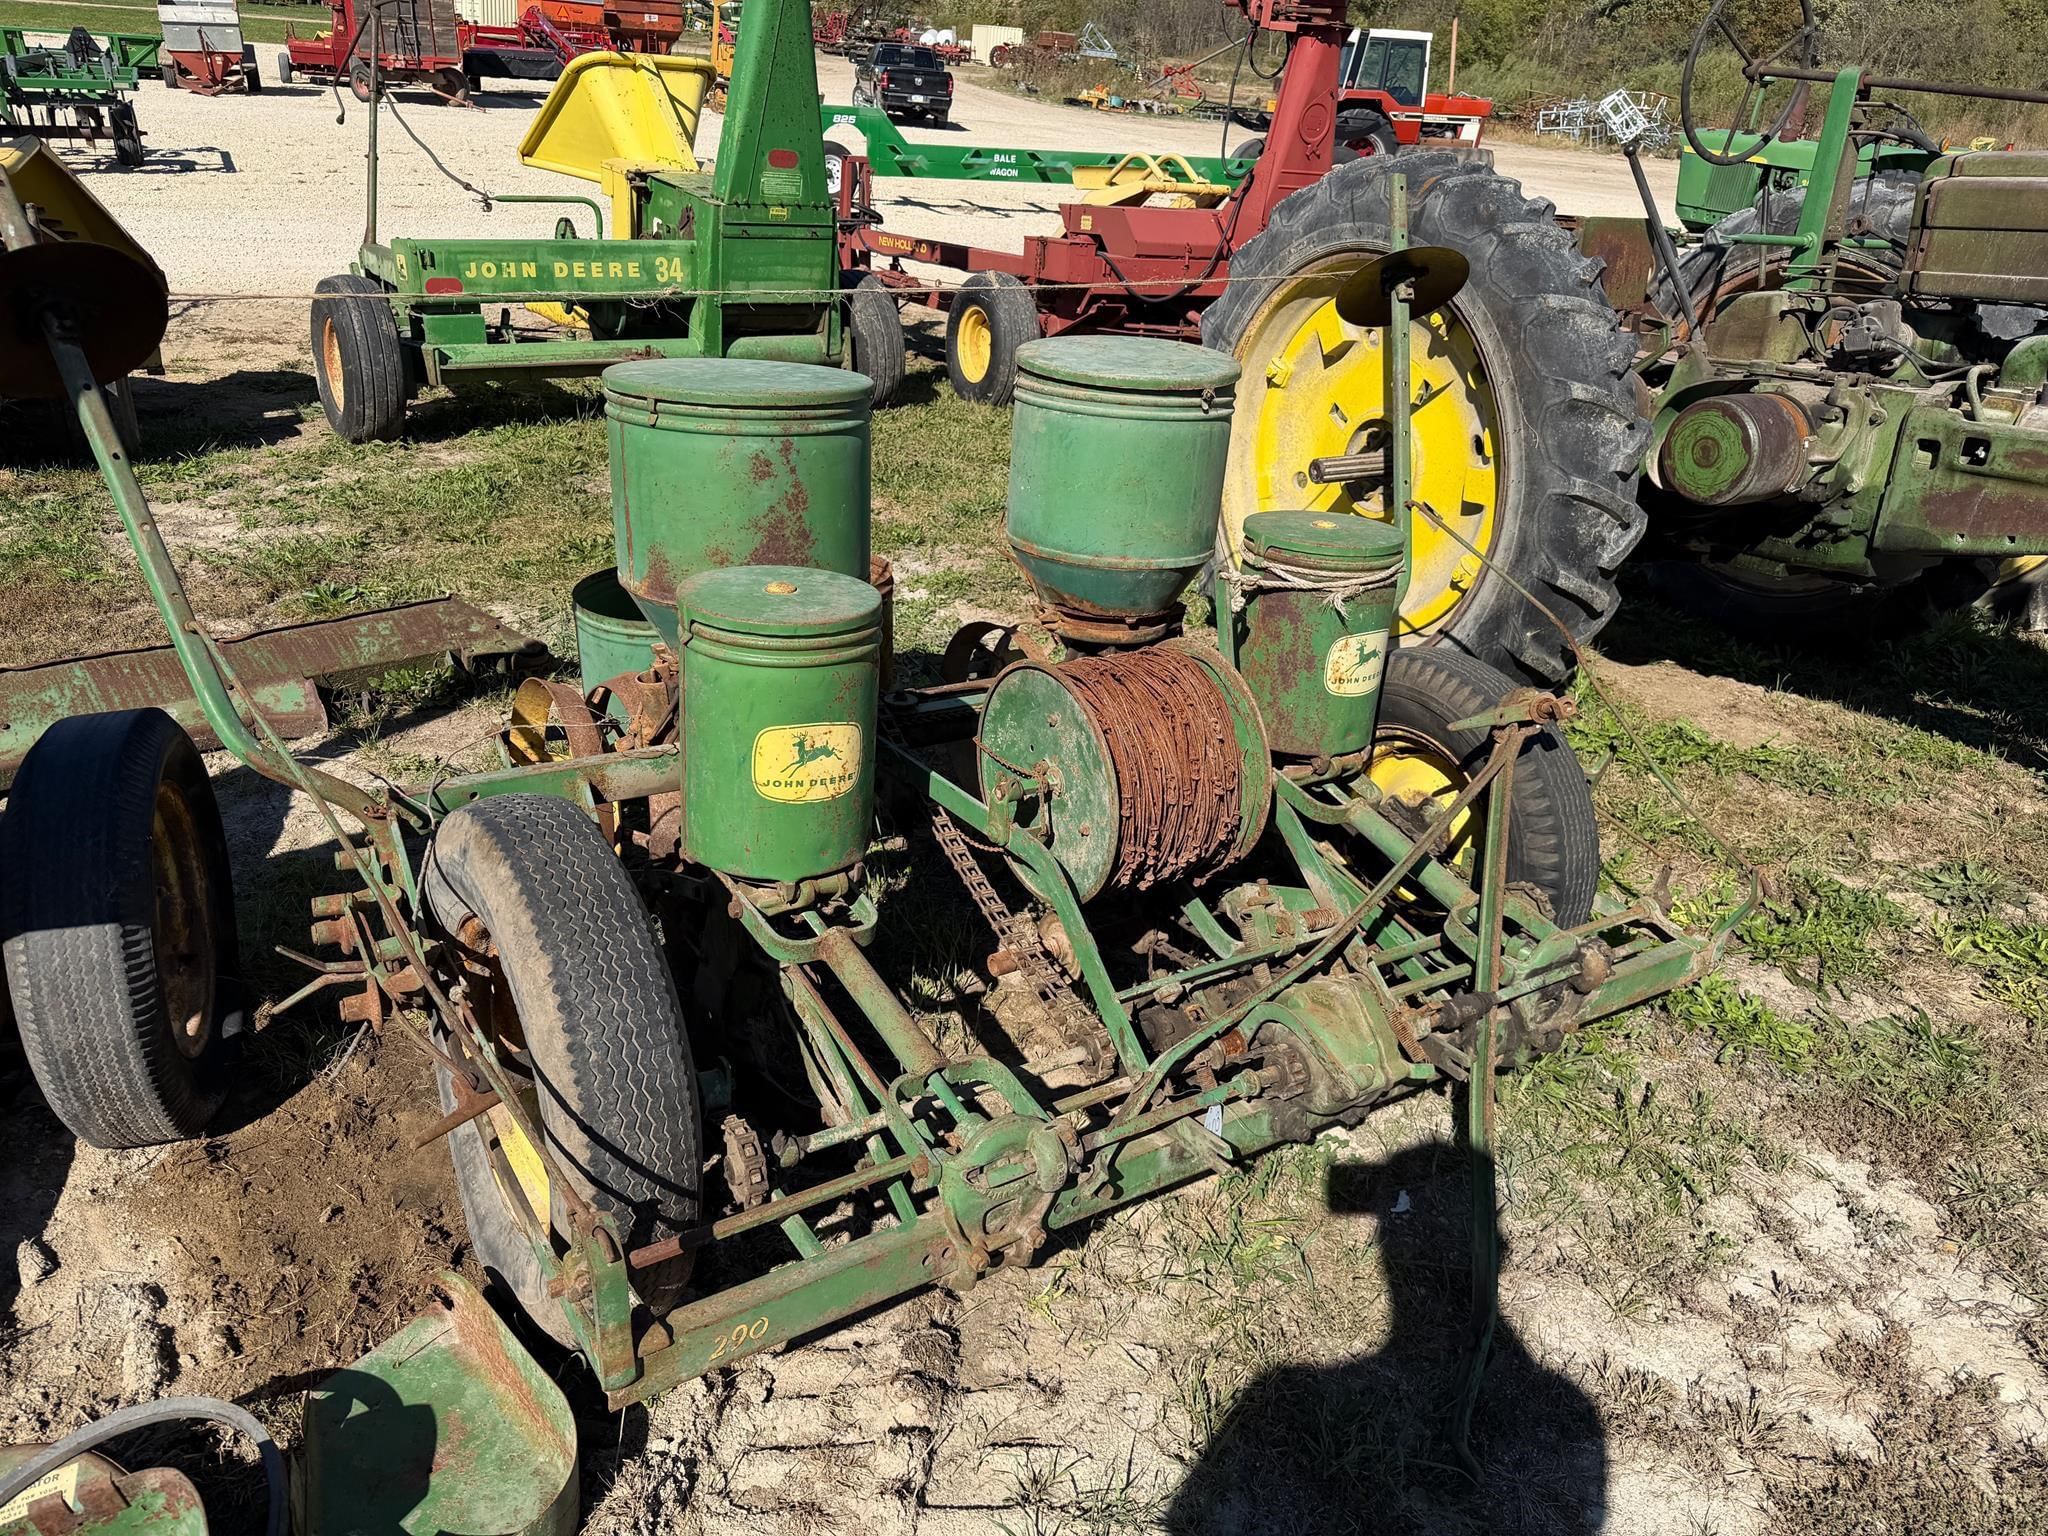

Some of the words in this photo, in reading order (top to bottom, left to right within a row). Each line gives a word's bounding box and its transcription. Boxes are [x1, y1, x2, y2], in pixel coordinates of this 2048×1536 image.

[993, 153, 1017, 164] BALE
[990, 167, 1019, 177] WAGON
[878, 236, 895, 248] NEW
[465, 261, 537, 278] JOHN
[554, 262, 641, 278] DEERE
[655, 256, 684, 283] 34
[1331, 677, 1360, 685] JOHN
[762, 779, 804, 788] JOHN
[810, 772, 856, 787] DEERE
[709, 1316, 769, 1361] 290
